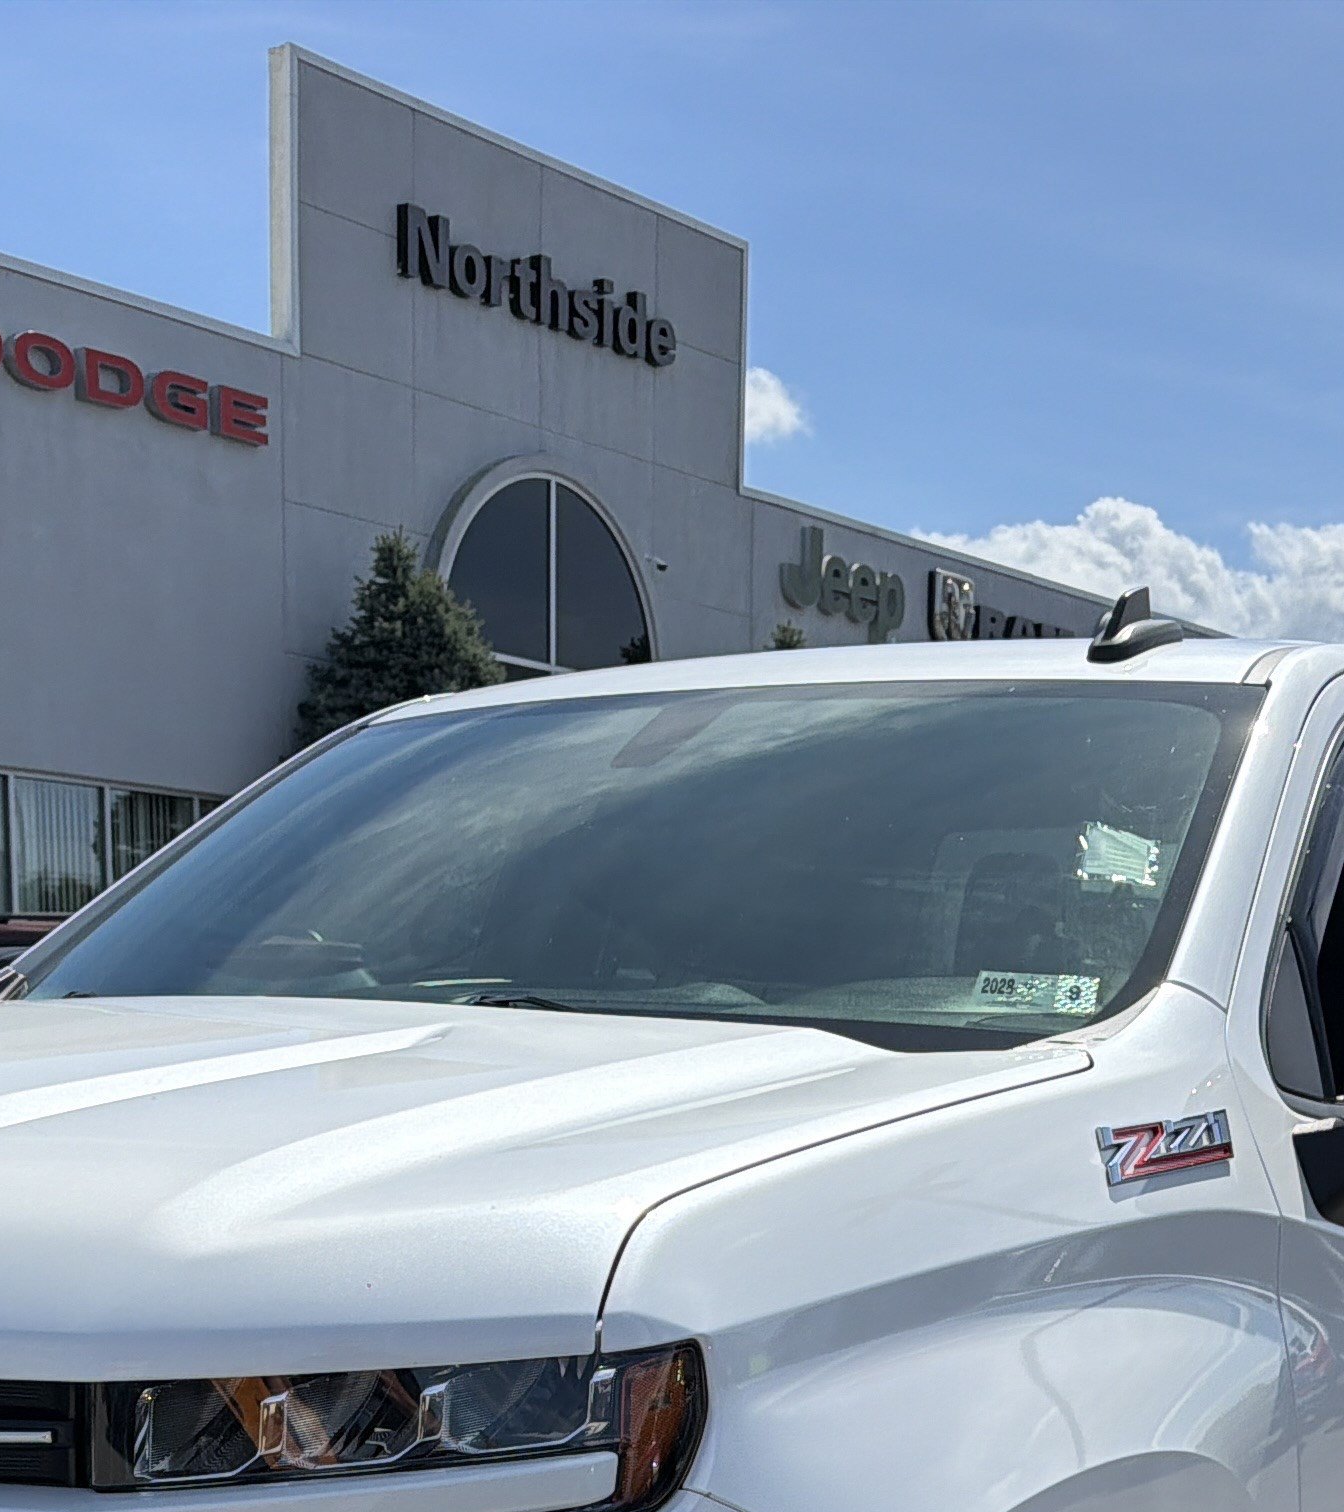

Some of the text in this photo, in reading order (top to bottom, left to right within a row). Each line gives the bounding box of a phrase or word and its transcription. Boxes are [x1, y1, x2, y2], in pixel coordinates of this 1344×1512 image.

[396, 203, 676, 367] Northside
[779, 526, 905, 644] Jeep
[1095, 1108, 1234, 1187] Z71
